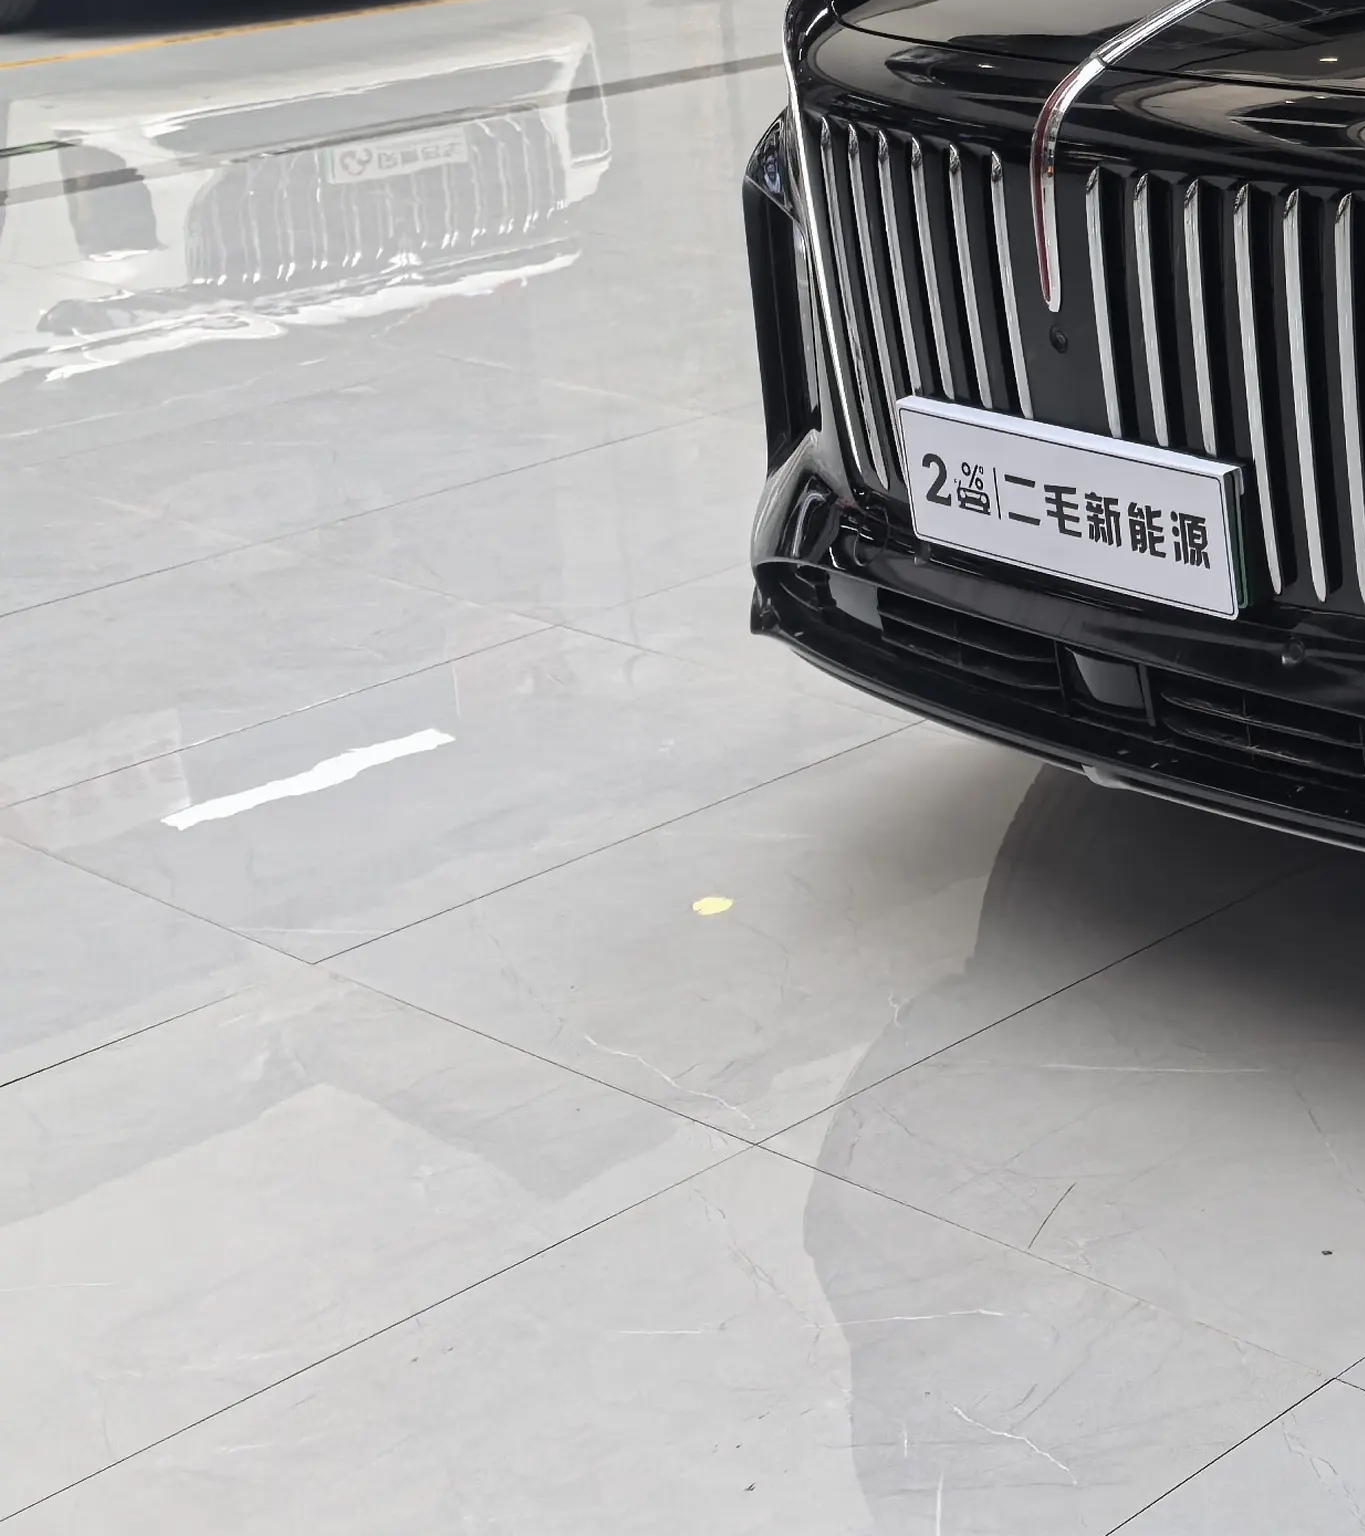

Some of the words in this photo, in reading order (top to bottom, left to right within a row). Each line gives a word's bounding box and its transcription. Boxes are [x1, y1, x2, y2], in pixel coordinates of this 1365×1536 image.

[1003, 473, 1211, 570] 二毛新能源
